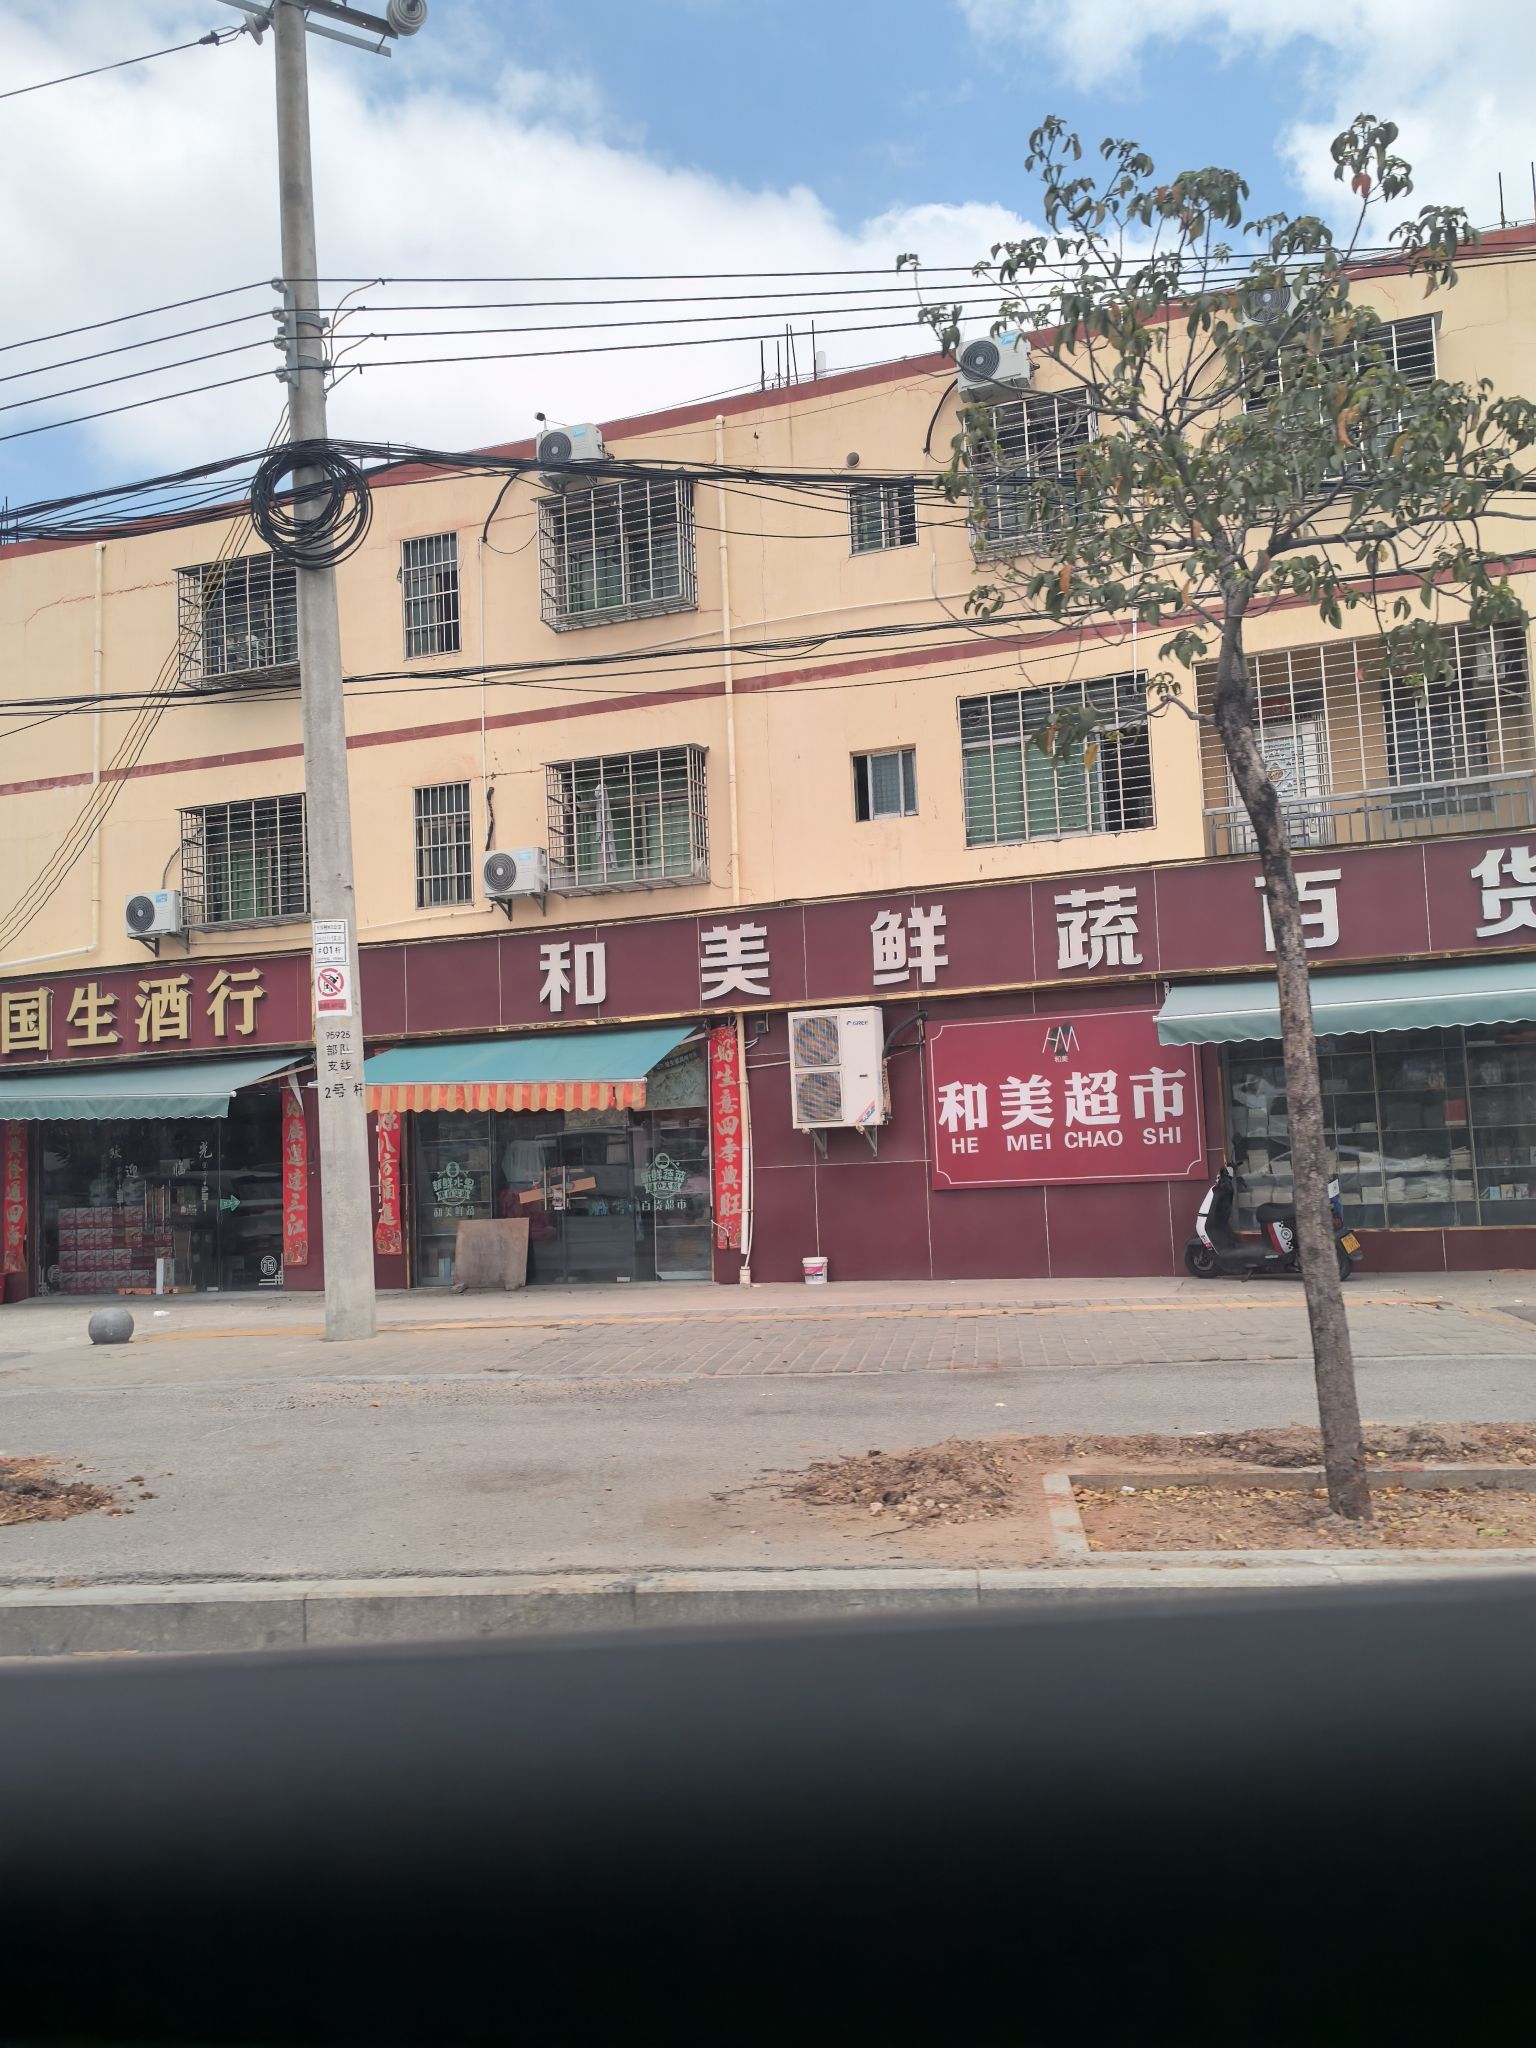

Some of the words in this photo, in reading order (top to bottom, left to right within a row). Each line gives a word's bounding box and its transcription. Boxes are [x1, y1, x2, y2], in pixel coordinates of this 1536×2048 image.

[1, 968, 266, 1054] 国生酒行
[326, 1043, 353, 1056] 部队
[327, 1059, 351, 1071] 支线
[937, 1066, 1186, 1133] 和美超市
[951, 1136, 979, 1154] HE
[1006, 1133, 1052, 1152] MEI
[1064, 1129, 1124, 1149] CHAO
[1142, 1126, 1182, 1145] SHI
